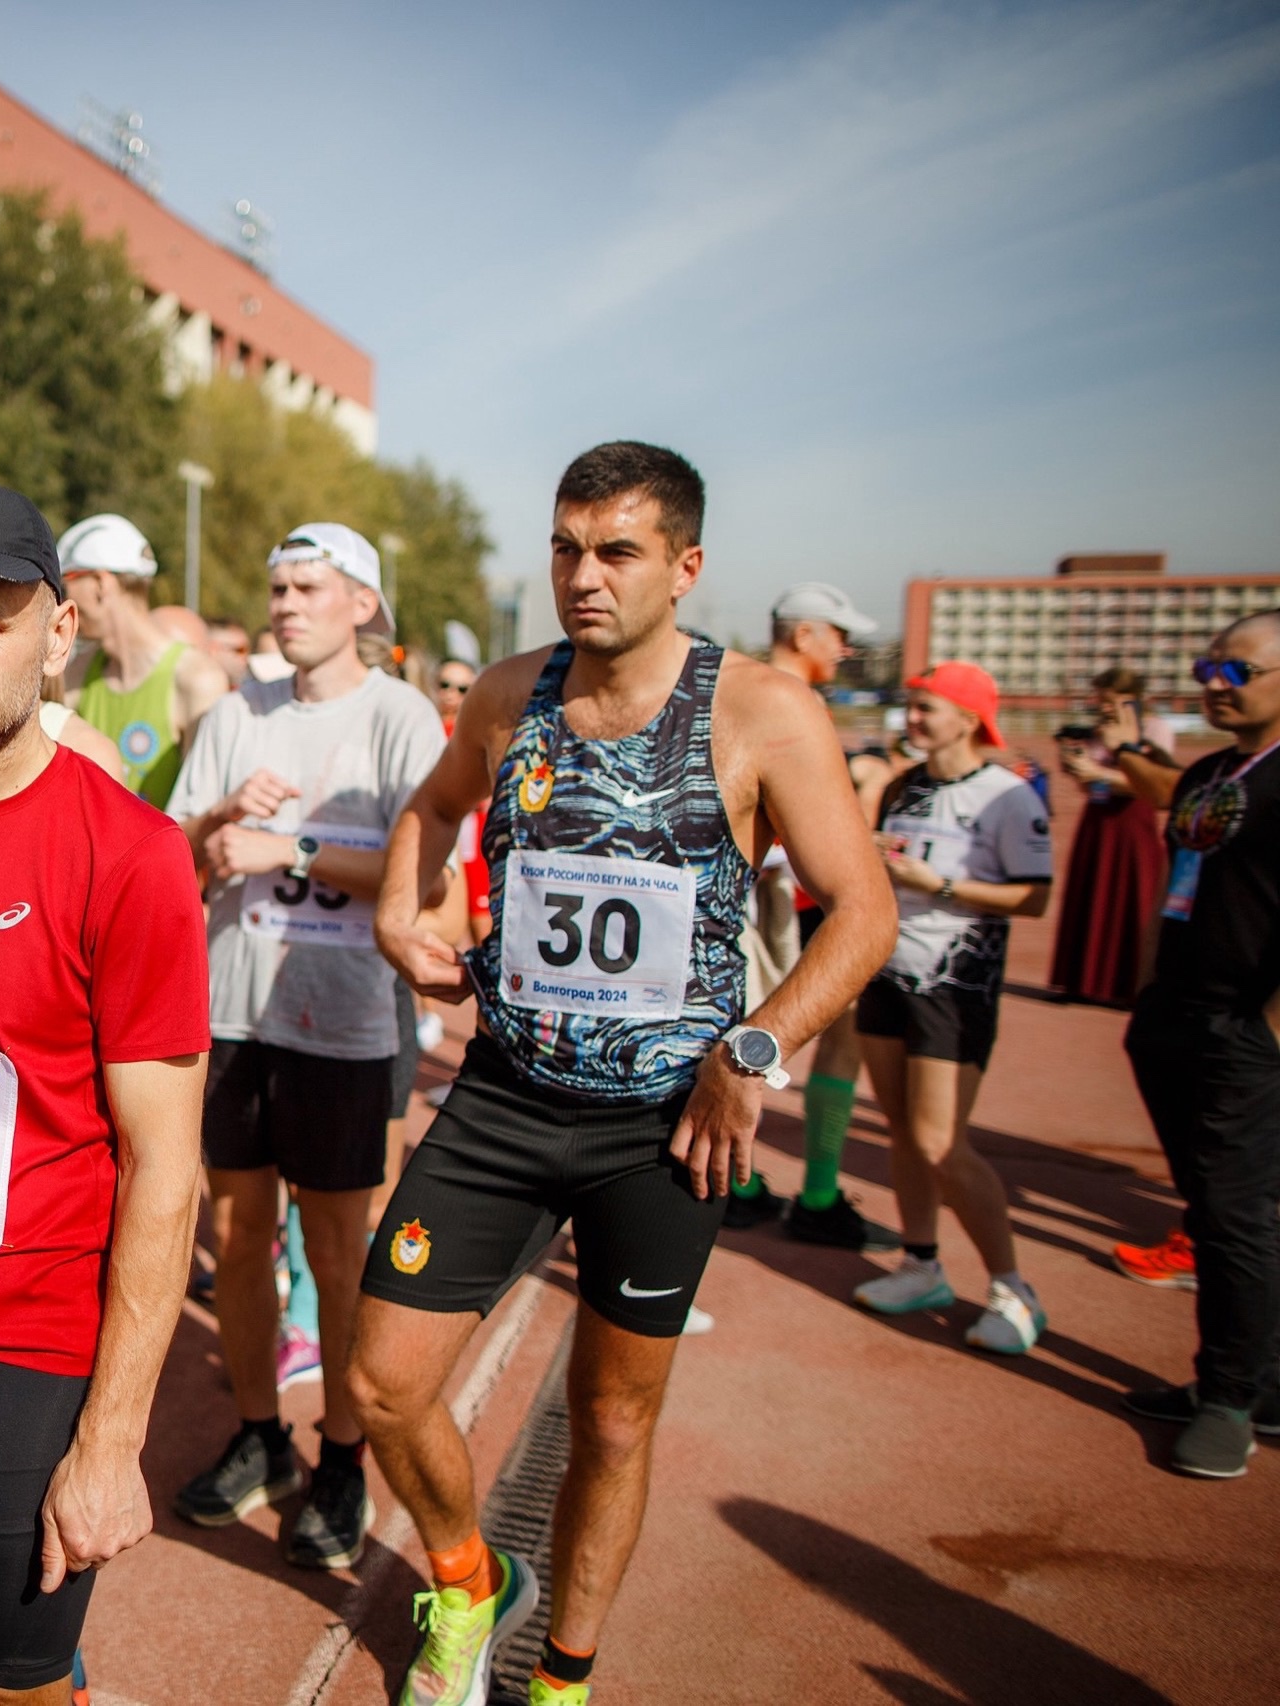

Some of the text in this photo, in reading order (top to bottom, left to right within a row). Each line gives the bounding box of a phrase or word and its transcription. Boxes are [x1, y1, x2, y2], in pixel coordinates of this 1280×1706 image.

[547, 867, 585, 883] РОССИИ
[586, 873, 600, 883] ПО
[601, 874, 624, 886] БЕГУ
[624, 877, 638, 887] НА
[639, 877, 652, 888] 24
[654, 879, 680, 892] ЧАСА
[536, 891, 642, 974] 30
[533, 980, 628, 1002] Волгоград 2024
